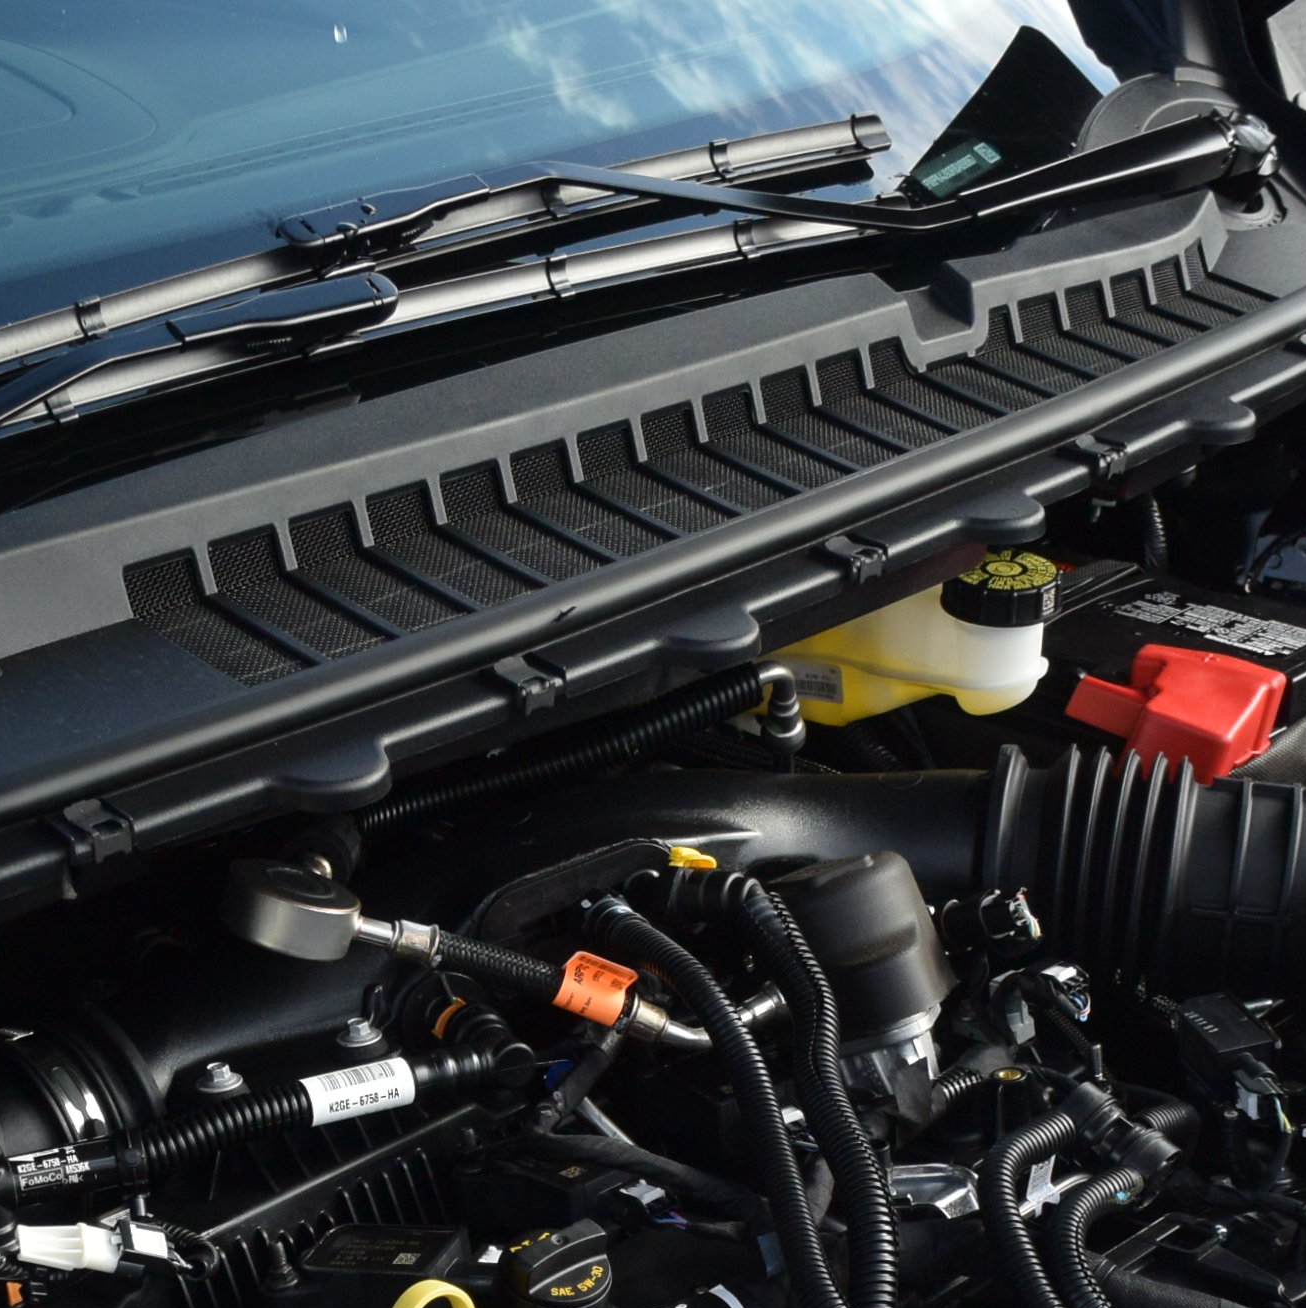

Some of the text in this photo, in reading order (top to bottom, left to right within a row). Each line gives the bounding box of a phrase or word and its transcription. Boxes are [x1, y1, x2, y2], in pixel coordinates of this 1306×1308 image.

[22, 1173, 62, 1187] FoMoCo
[550, 1265, 604, 1297] SAE 5W-30
